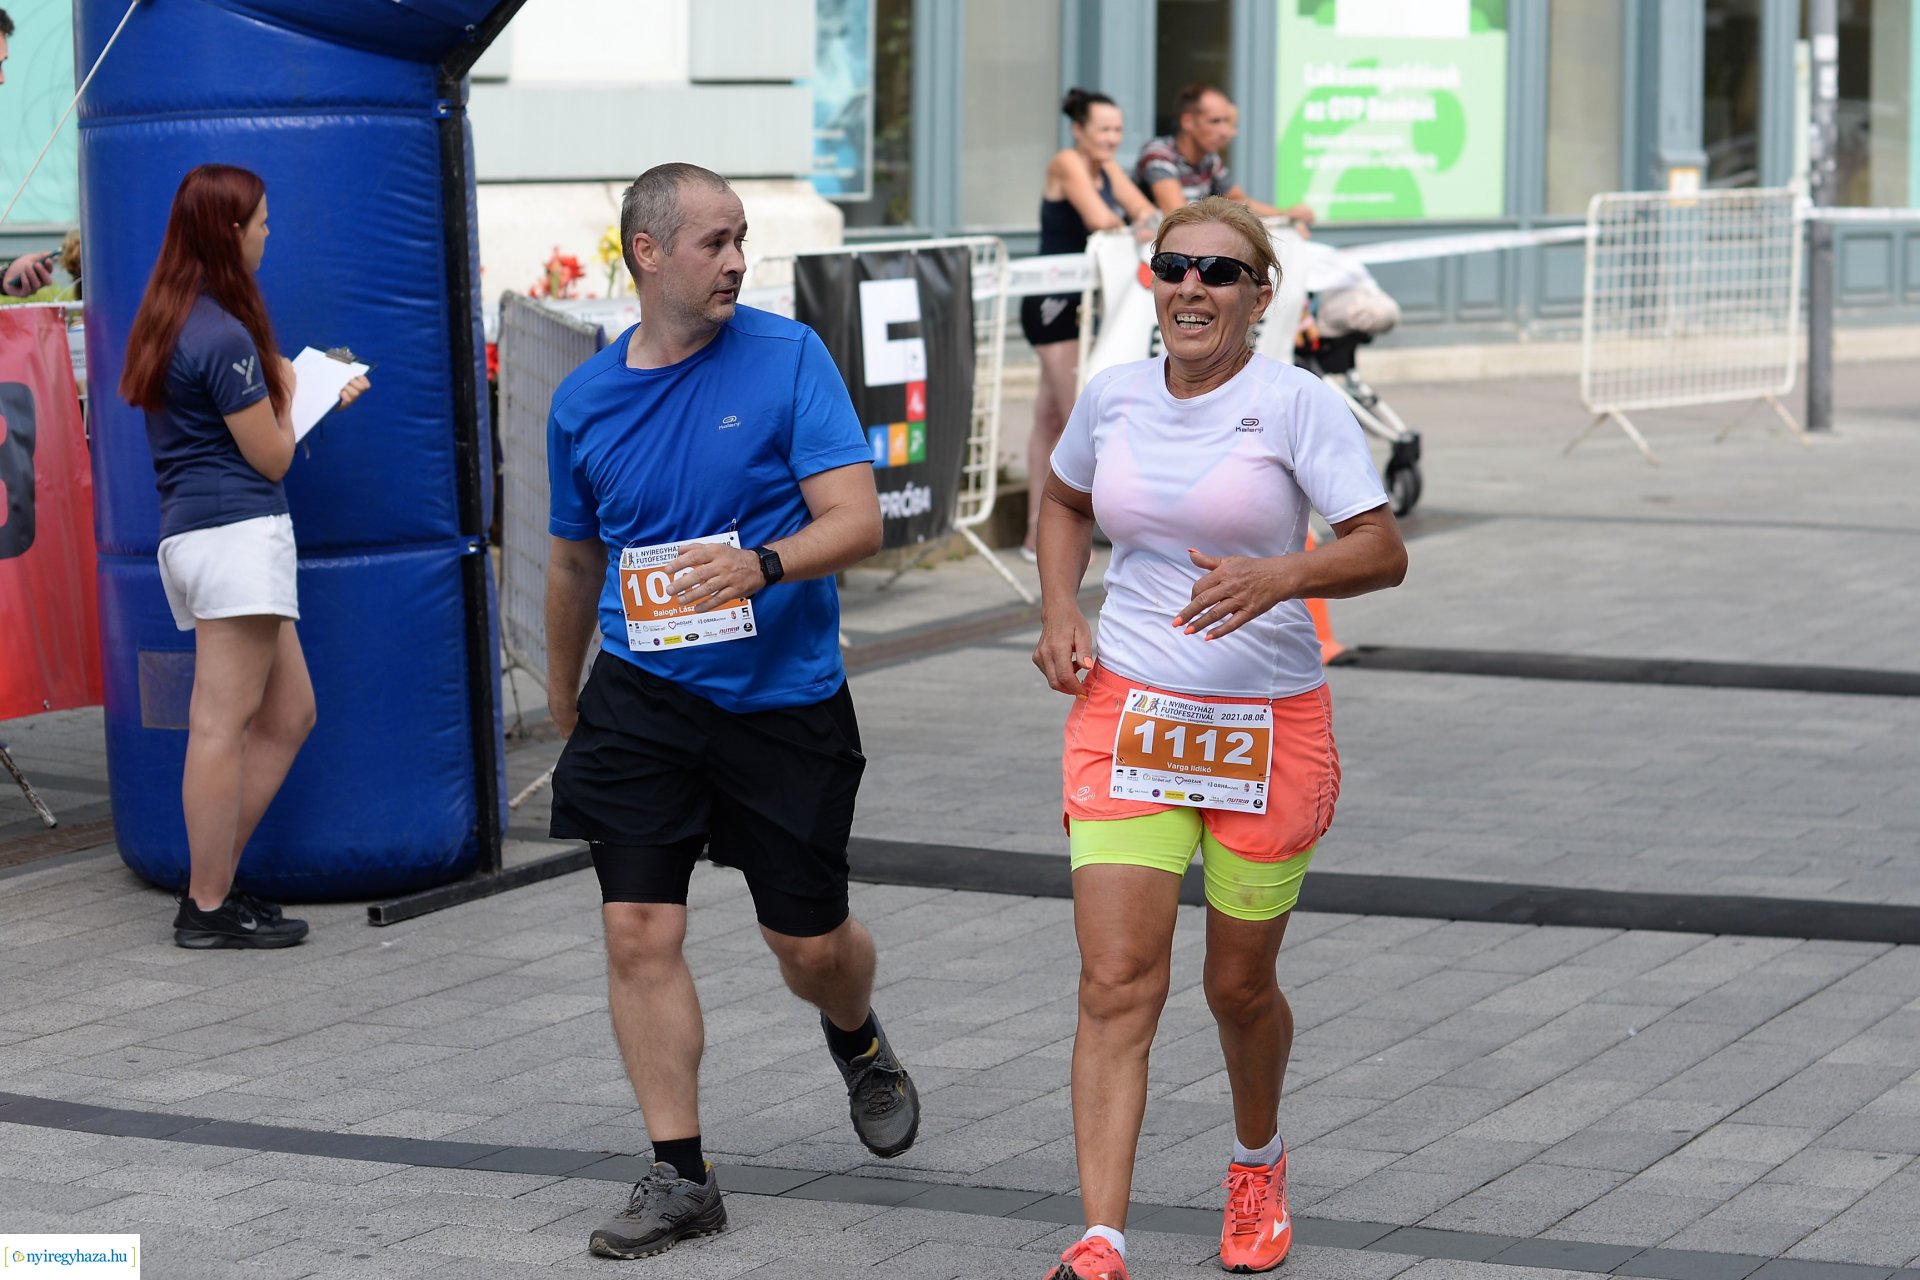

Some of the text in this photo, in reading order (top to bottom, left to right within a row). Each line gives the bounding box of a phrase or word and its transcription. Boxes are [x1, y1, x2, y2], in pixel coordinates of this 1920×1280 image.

[1327, 97, 1365, 121] OTP
[640, 545, 681, 557] NYÍREGYHÁ
[653, 604, 697, 617] Balogh Lász
[1160, 706, 1215, 720] FUTÓFESZTIVÁL
[1220, 713, 1266, 722] 2021.08.08.
[1168, 700, 1215, 714] NYÍREGYHÁZI
[1133, 720, 1254, 766] 1112
[1167, 762, 1212, 773] Varga Ildikó
